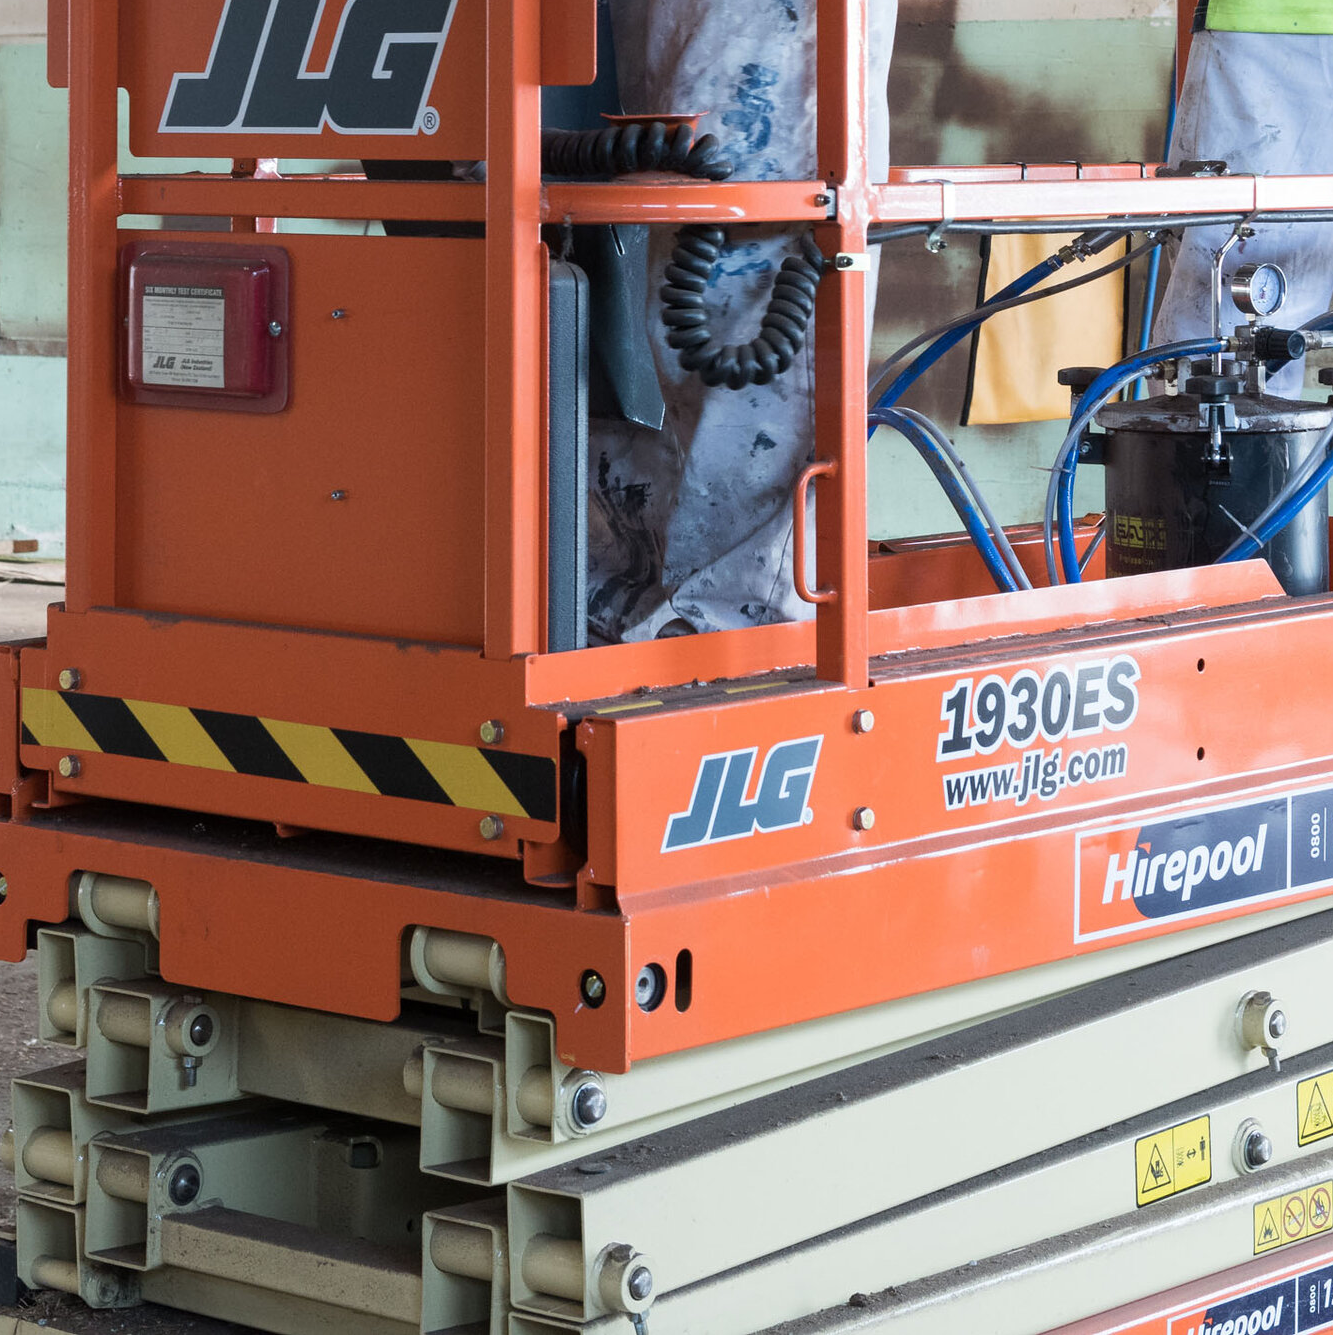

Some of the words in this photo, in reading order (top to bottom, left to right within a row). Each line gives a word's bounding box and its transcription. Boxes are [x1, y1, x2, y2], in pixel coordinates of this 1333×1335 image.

[153, 355, 176, 370] JLG
[940, 659, 1138, 755] 1930ES
[661, 734, 824, 854] JLG
[945, 746, 1127, 807] www.jlg.com
[1101, 823, 1268, 905] Hirepool
[1310, 812, 1321, 859] 0800
[1309, 1284, 1317, 1314] 0800
